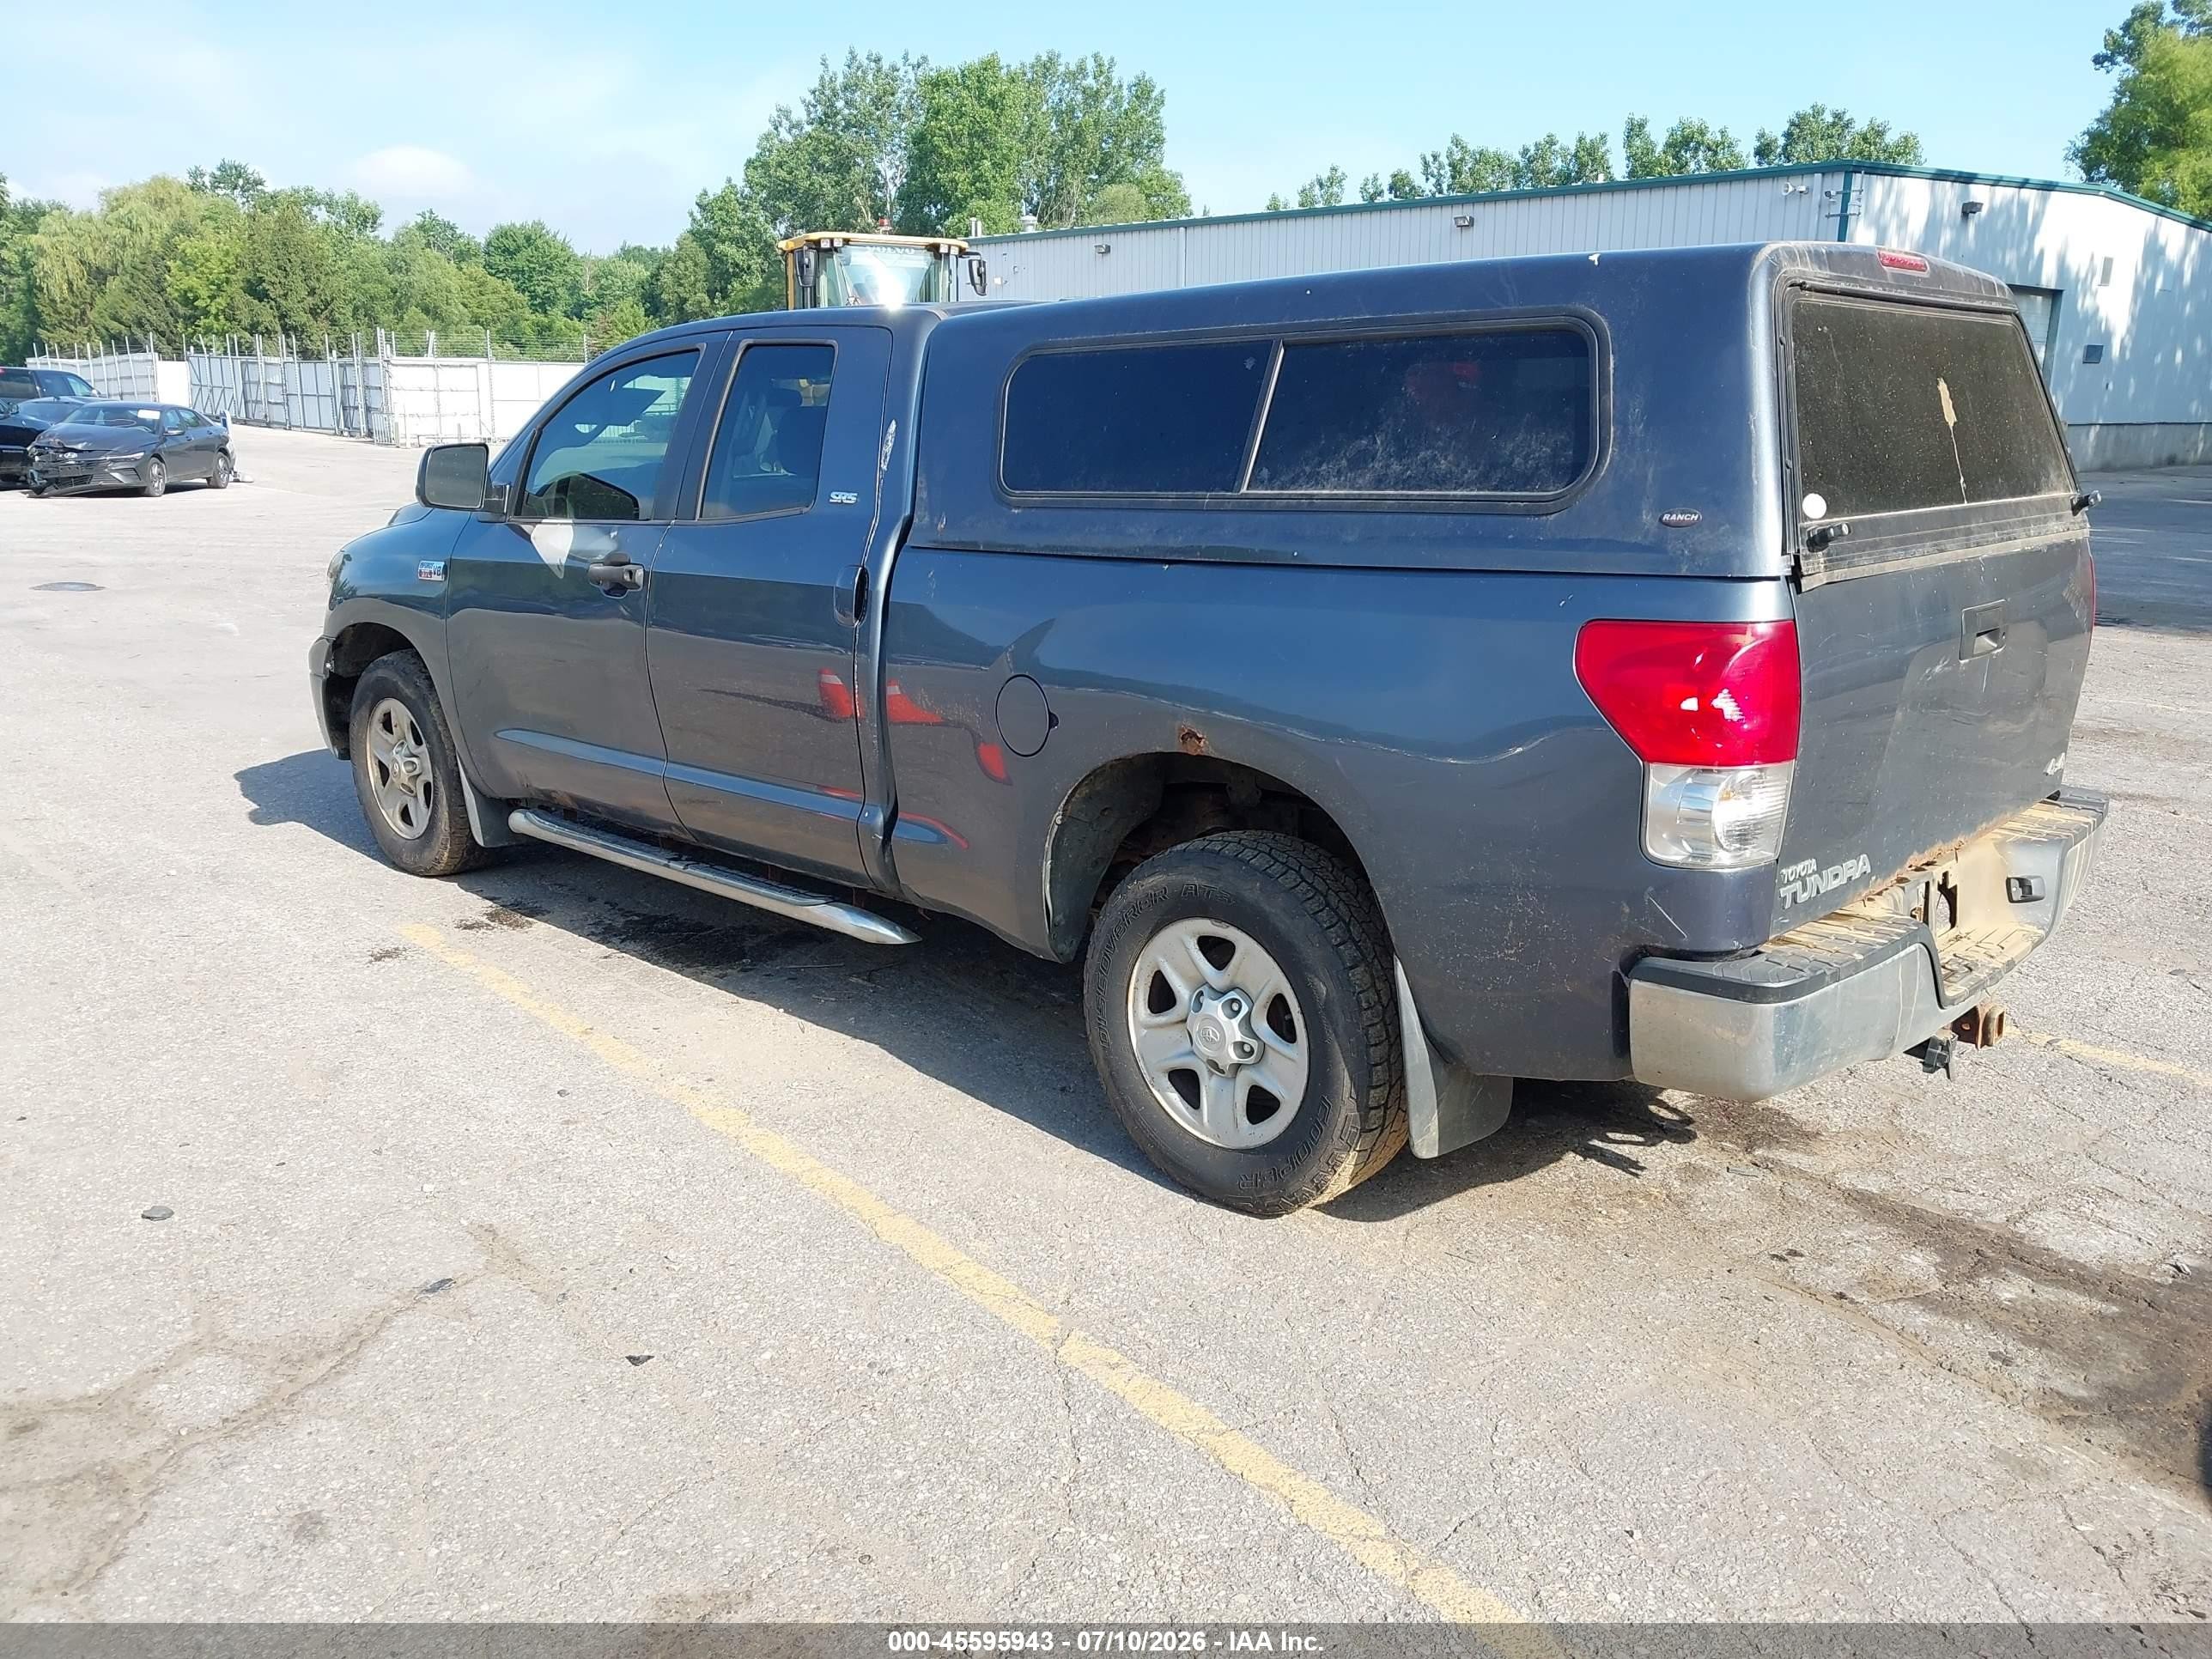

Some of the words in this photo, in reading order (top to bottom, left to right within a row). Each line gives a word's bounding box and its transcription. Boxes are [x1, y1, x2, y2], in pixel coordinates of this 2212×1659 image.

[1779, 854, 1871, 909] TUNDRA
[1781, 859, 1817, 883] TOYOTA
[1237, 1095, 1331, 1190] COOPER
